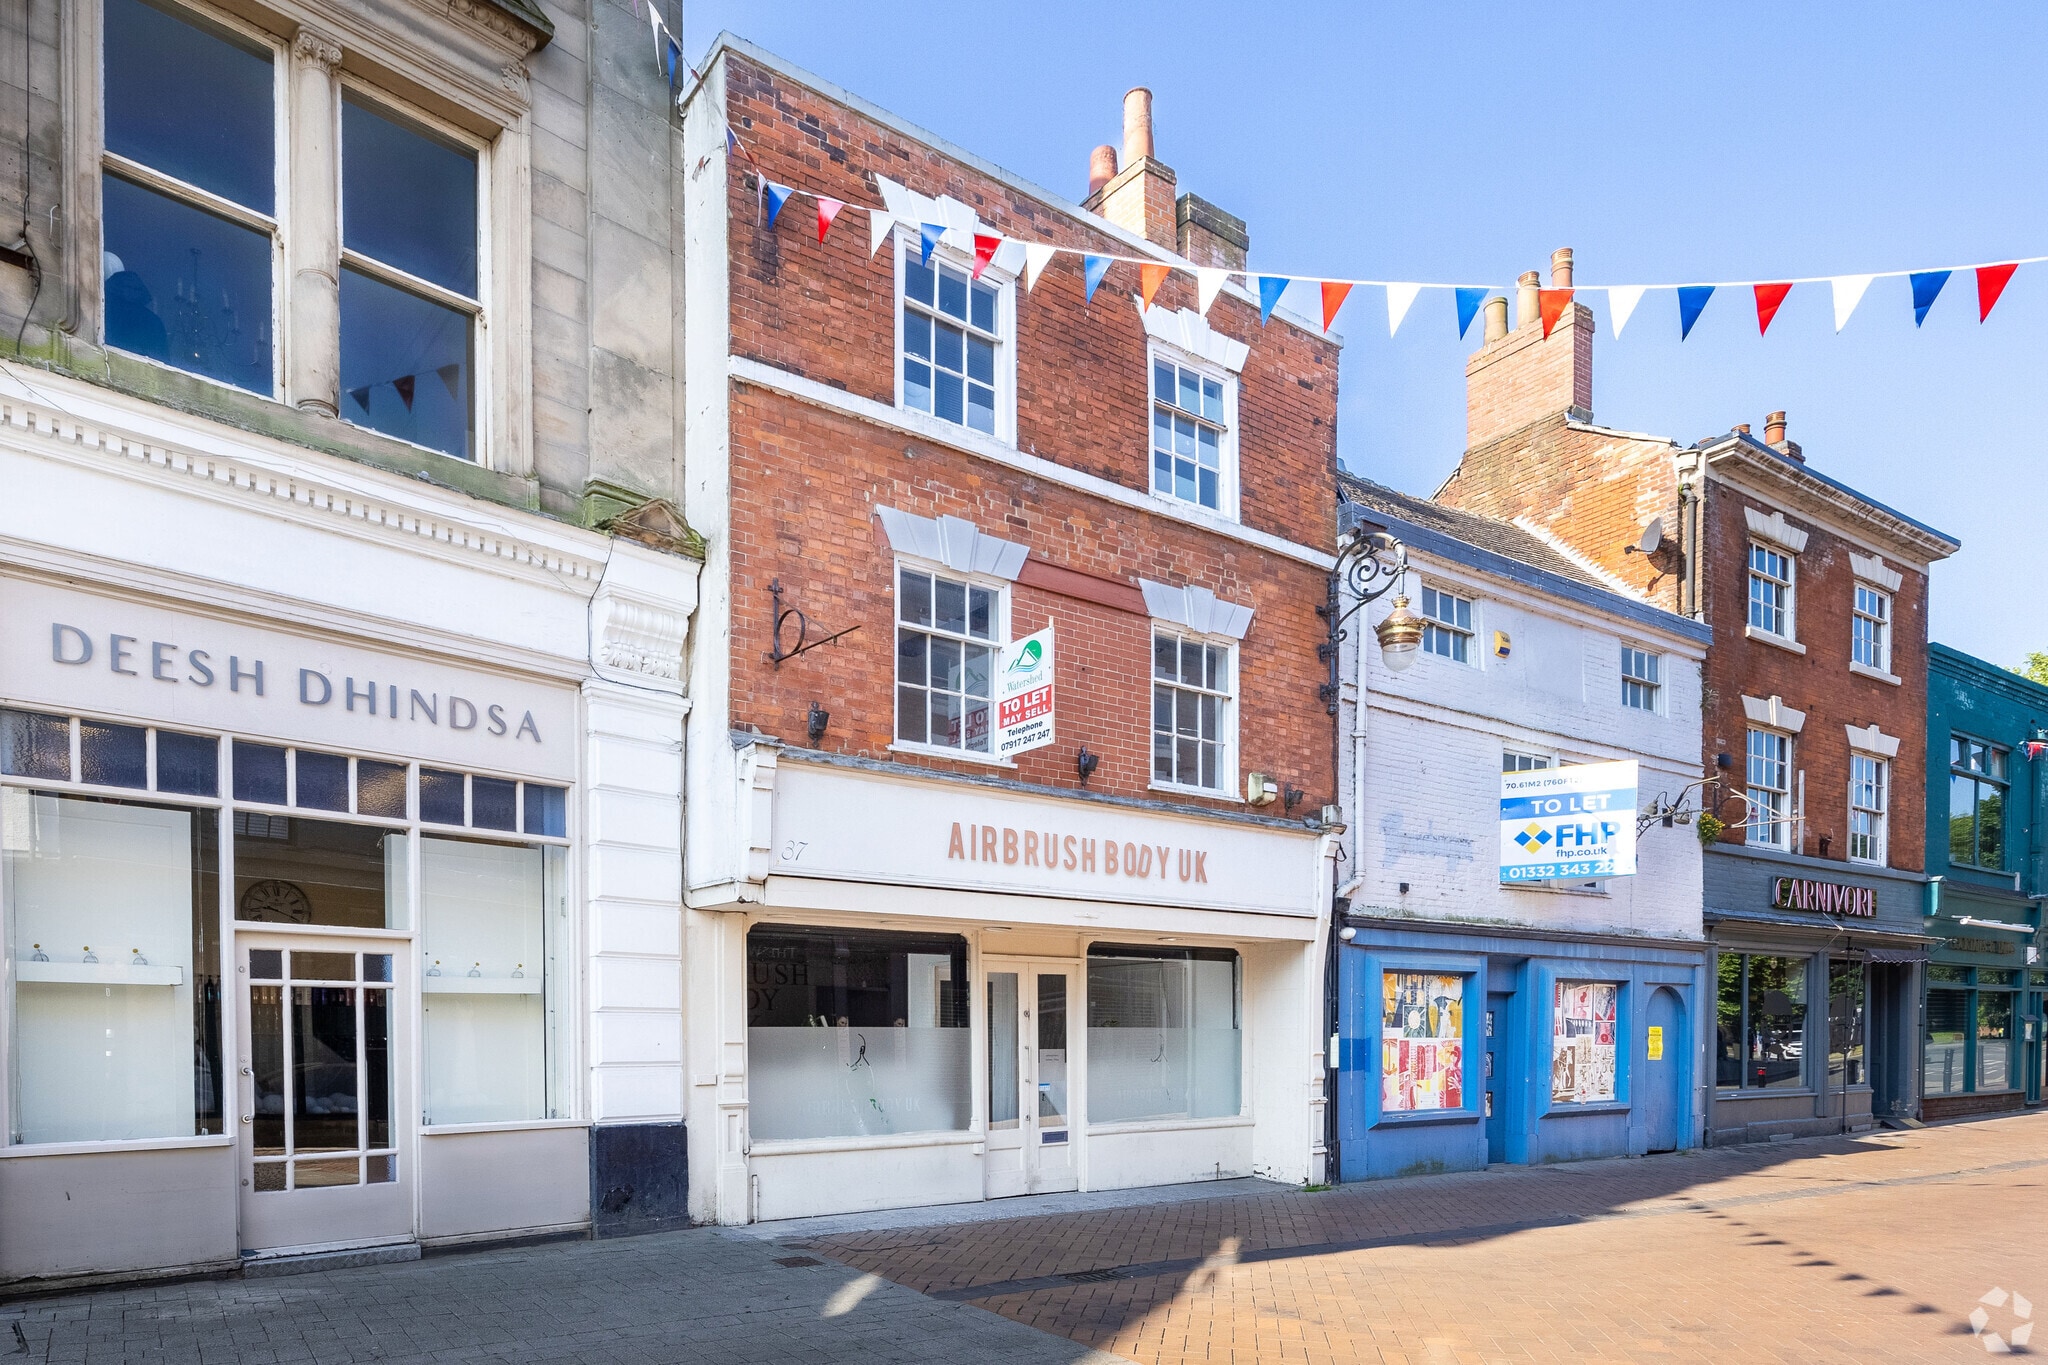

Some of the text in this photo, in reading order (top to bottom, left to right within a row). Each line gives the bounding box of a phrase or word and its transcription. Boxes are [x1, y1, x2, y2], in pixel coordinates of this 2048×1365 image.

[51, 622, 542, 743] DEESH DHINDSA
[1006, 671, 1043, 692] Watershed
[1003, 688, 1049, 715] TO LET
[1003, 704, 1048, 726] MAY SELL
[1008, 720, 1043, 737] Telephone
[1001, 729, 1050, 751] 07917 247 247
[1505, 780, 1541, 789] 70.61M2
[1531, 793, 1612, 815] TO LET
[1556, 821, 1621, 848] FHP
[781, 840, 809, 861] 37
[947, 822, 1208, 883] AIRBRUSH BODY UK
[1556, 847, 1607, 859] fhp.co.uk
[1509, 865, 1555, 879] 01332
[1560, 862, 1590, 876] 343
[1775, 877, 1877, 918] CARNIVORE
